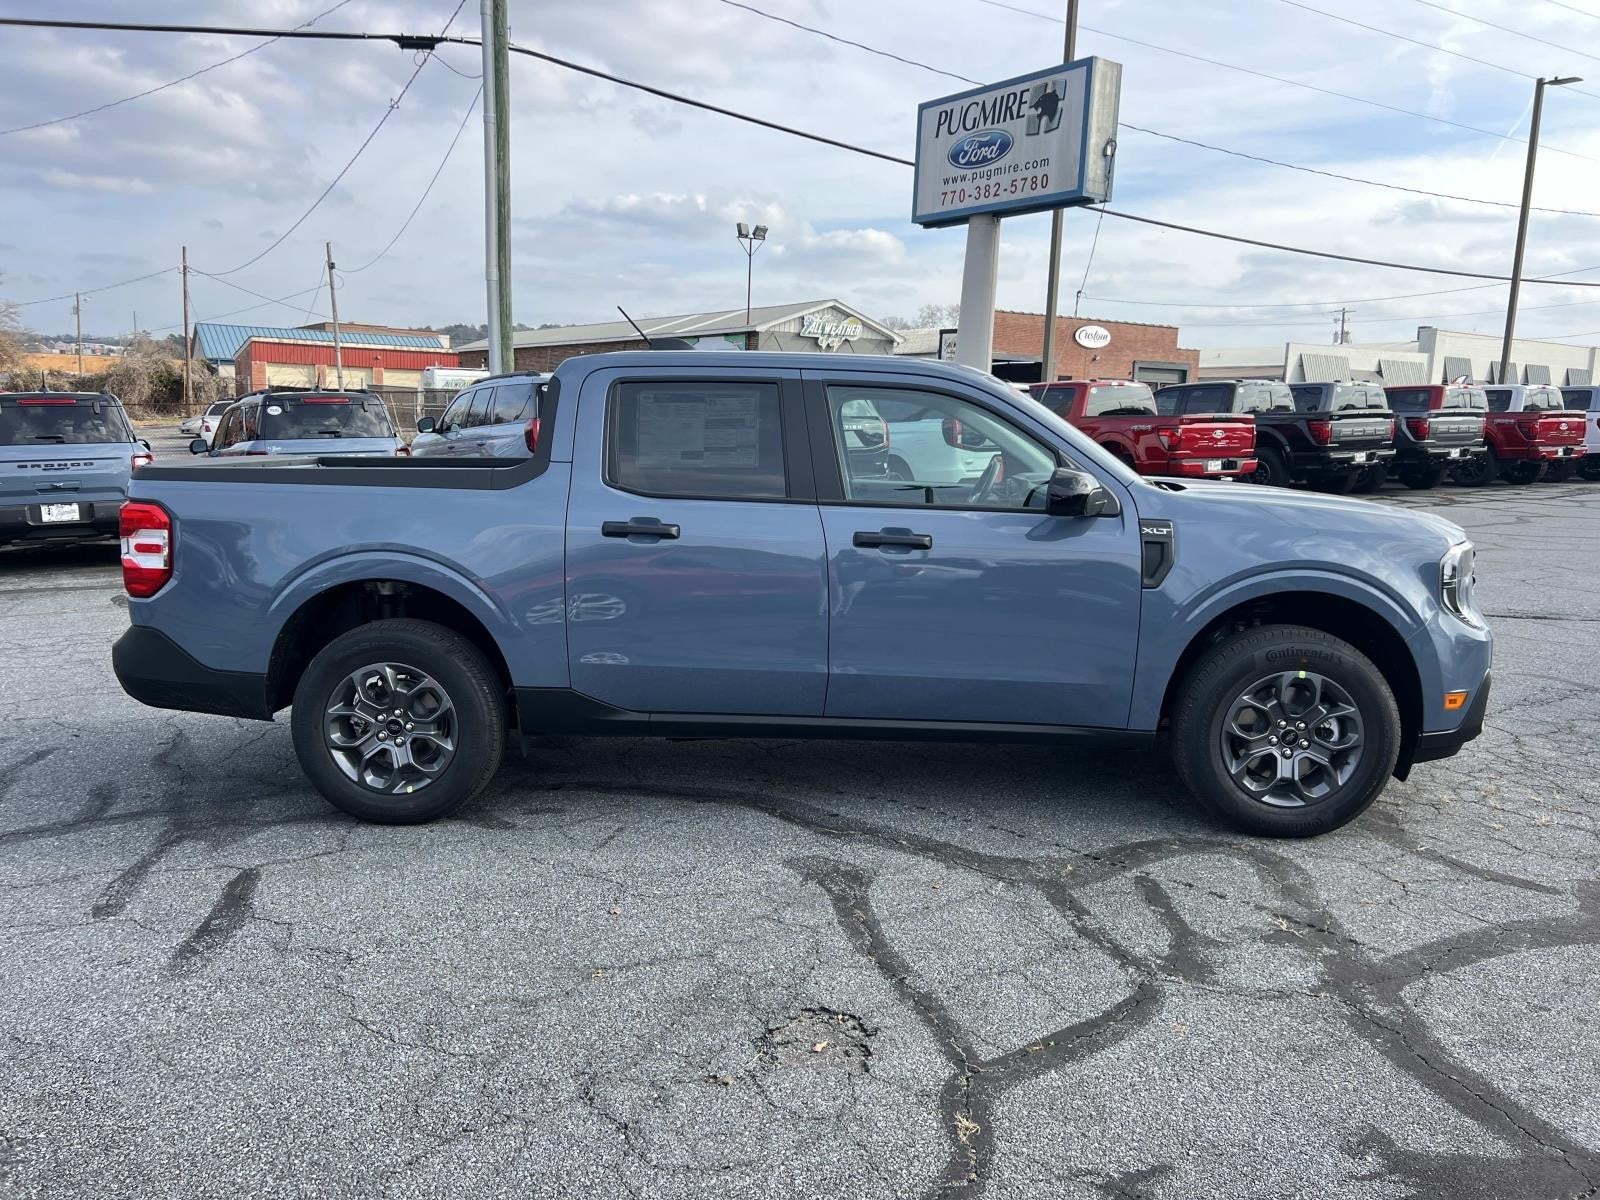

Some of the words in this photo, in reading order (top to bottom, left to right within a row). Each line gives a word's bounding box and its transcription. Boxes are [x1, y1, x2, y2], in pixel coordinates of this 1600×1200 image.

[935, 88, 1030, 138] PUGMIRE
[958, 135, 1000, 164] Ford
[942, 157, 1050, 186] www.pugmire.com
[941, 173, 1049, 206] 770-382-5780
[806, 321, 824, 335] ALL
[1142, 527, 1172, 535] XLT
[1265, 646, 1334, 662] Continental
